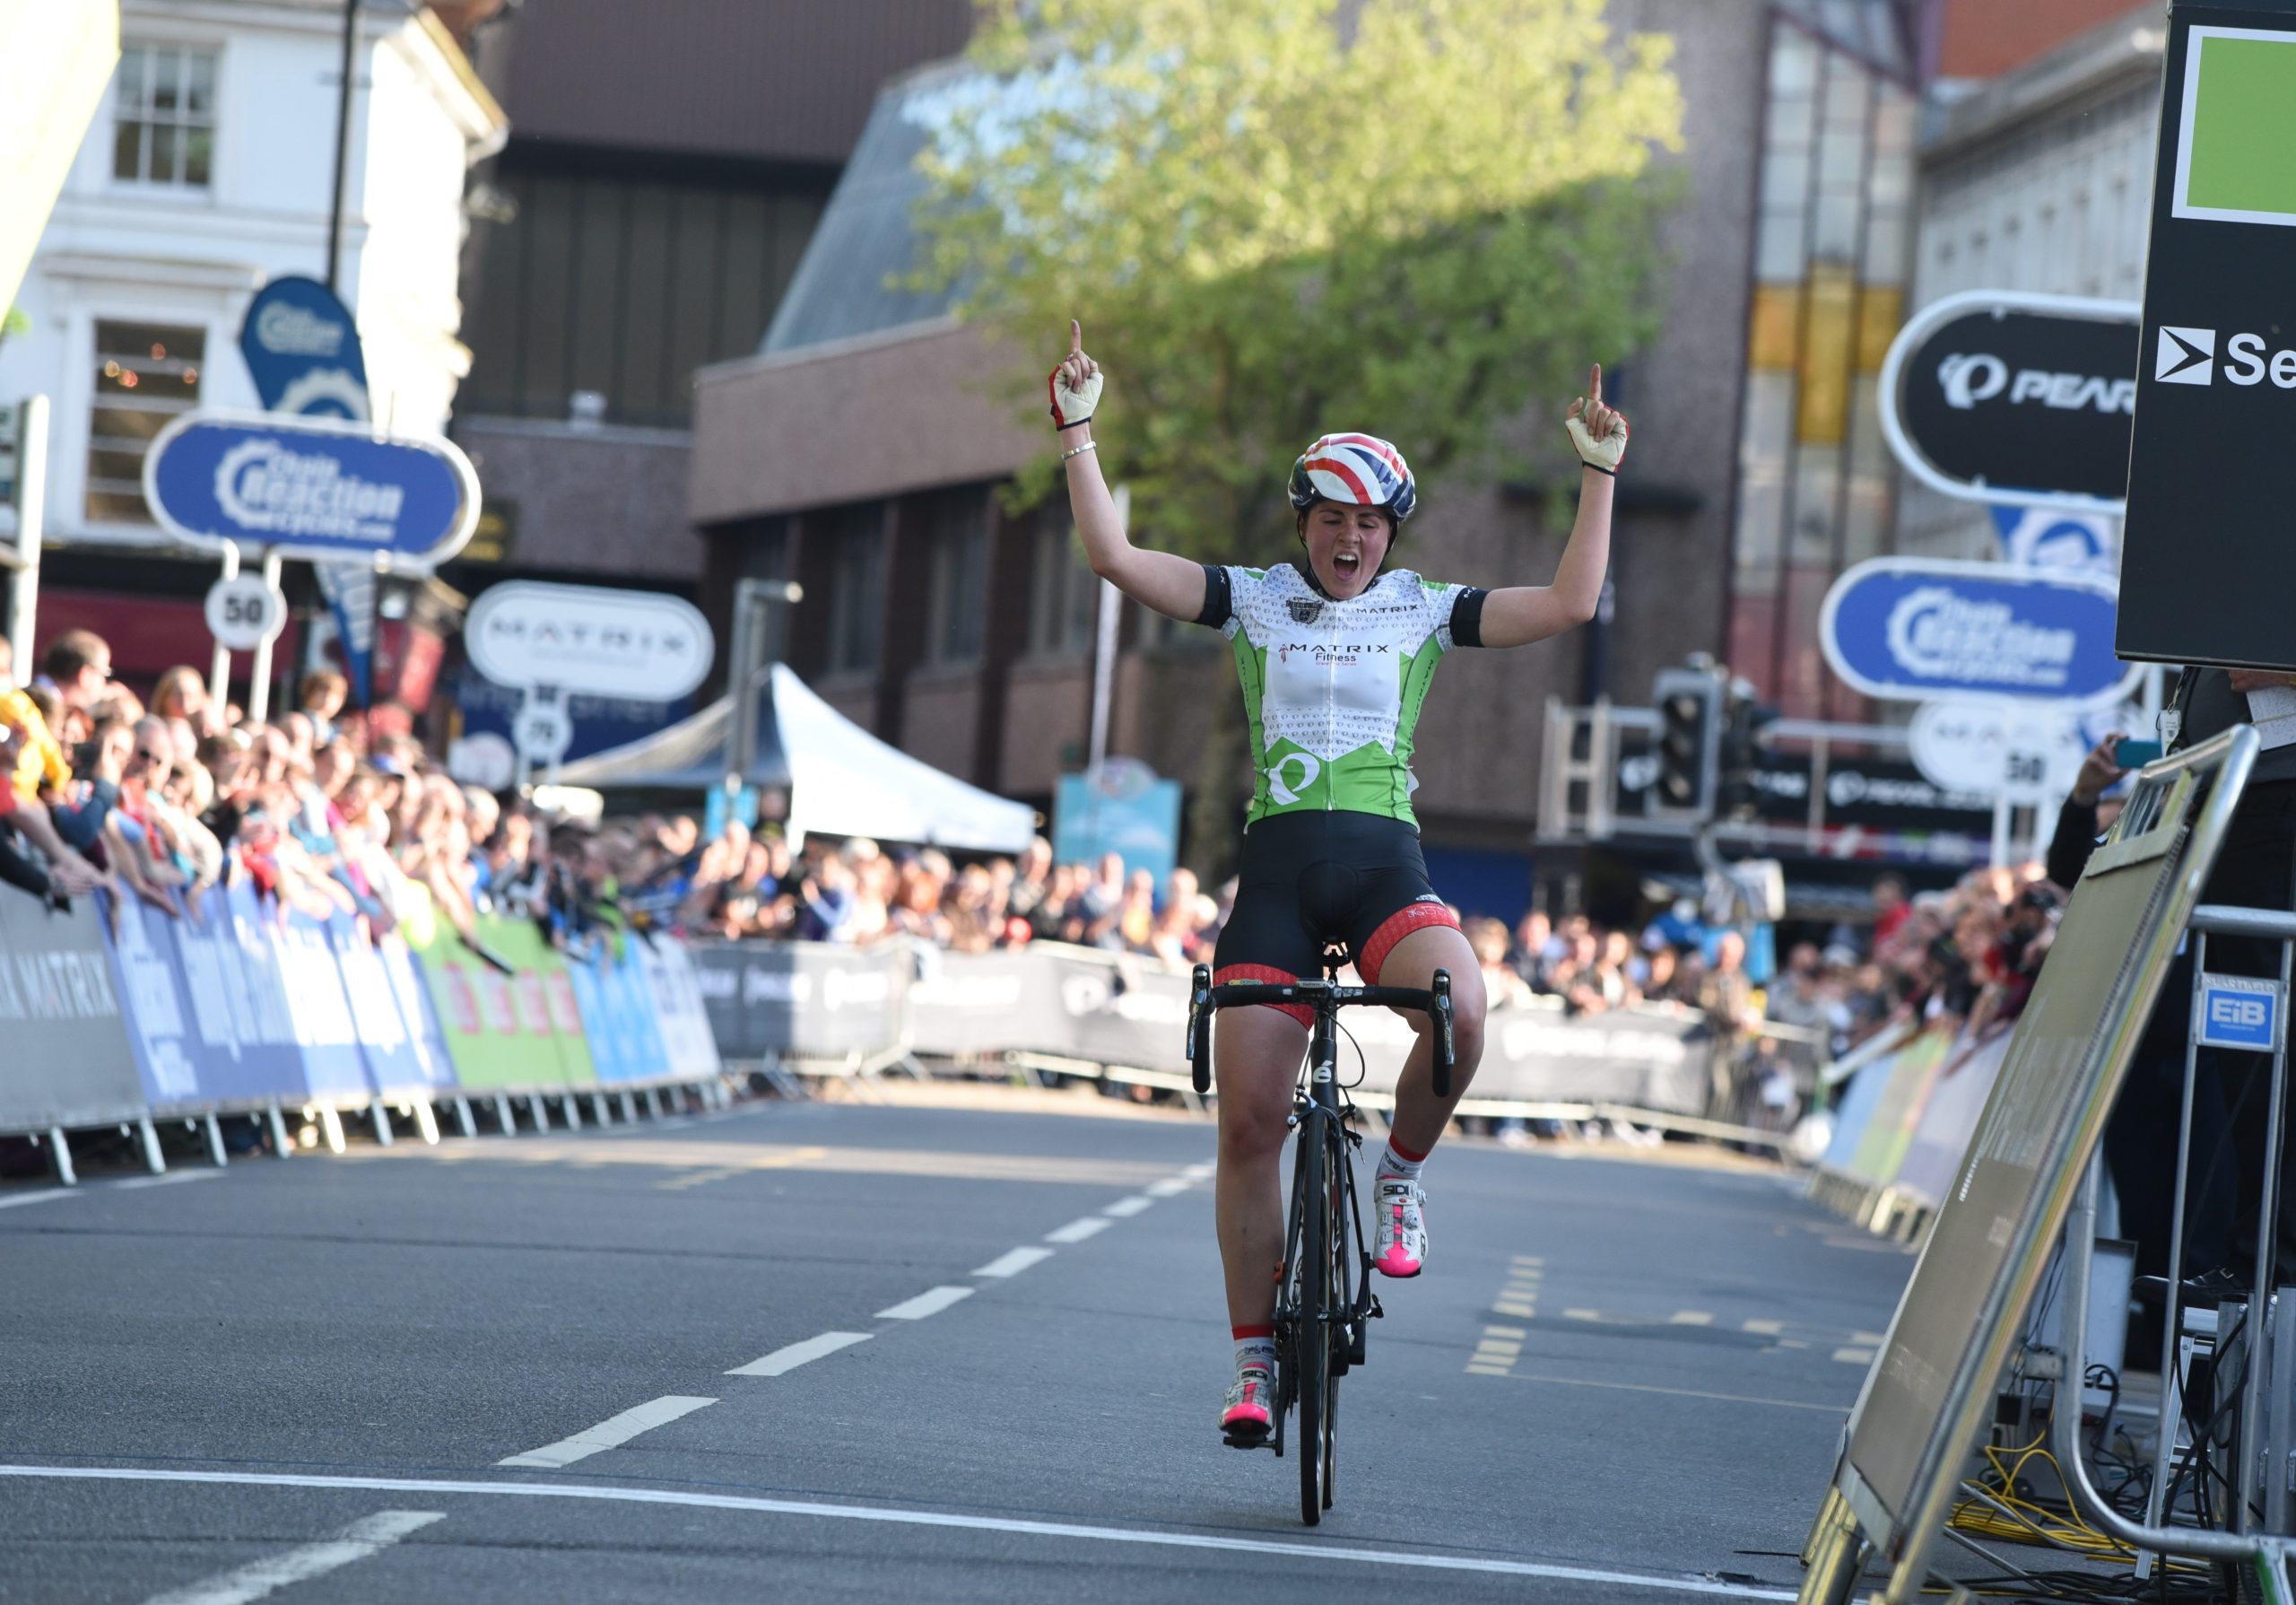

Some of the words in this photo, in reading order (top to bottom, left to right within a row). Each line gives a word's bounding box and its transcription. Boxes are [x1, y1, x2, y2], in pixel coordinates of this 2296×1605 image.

[224, 594, 265, 625] 50
[1356, 604, 1420, 615] MATRIX
[490, 619, 687, 655] MATRIX
[1290, 643, 1389, 653] MATRIX
[1315, 652, 1357, 662] Fitness
[2211, 997, 2266, 1026] EiB
